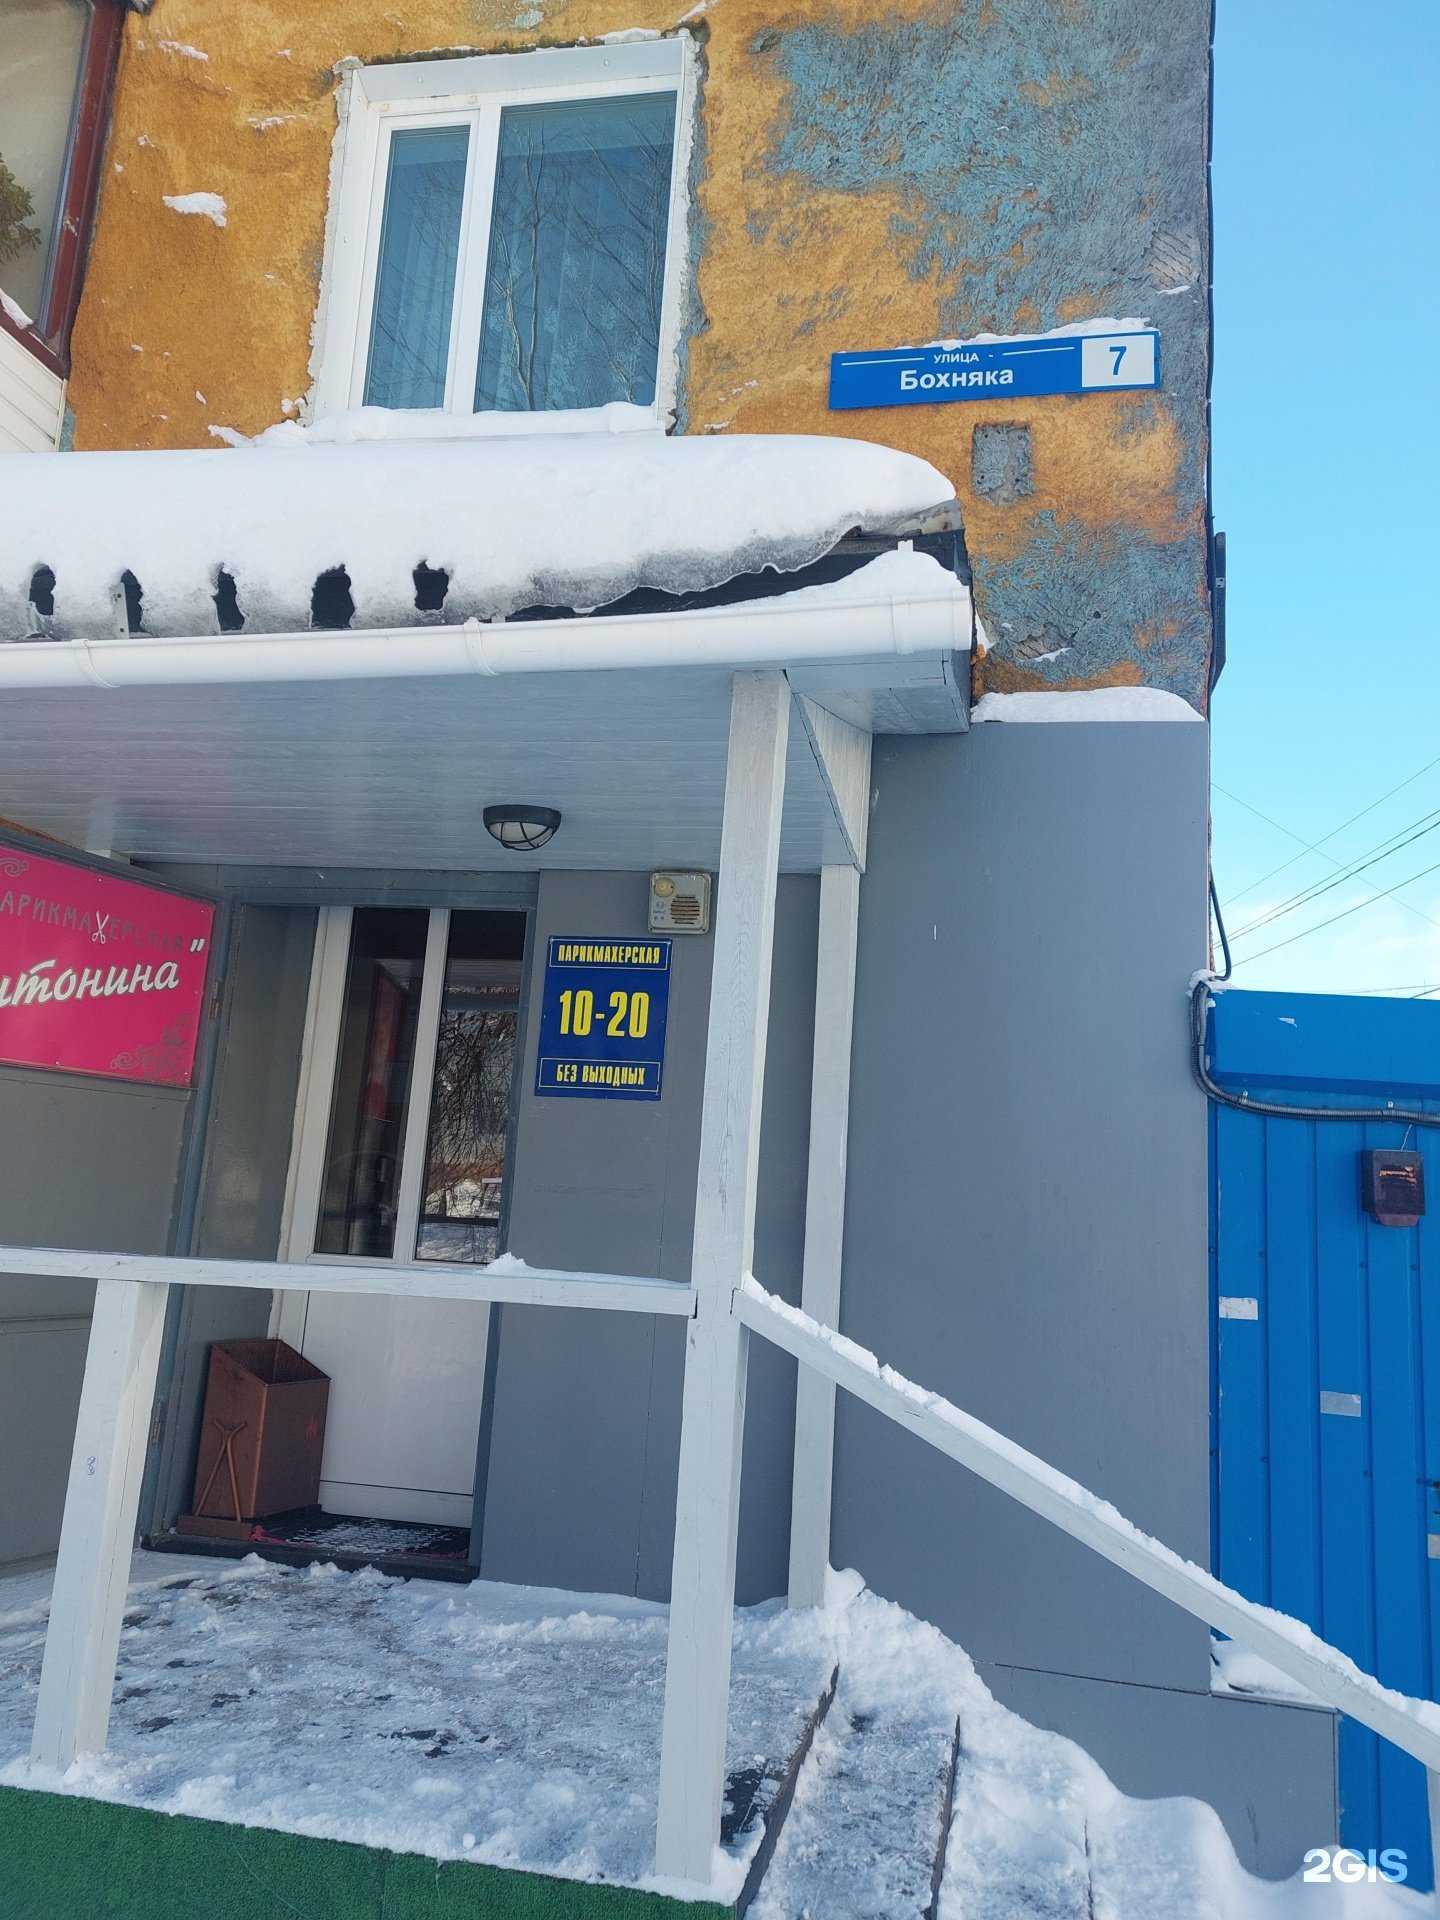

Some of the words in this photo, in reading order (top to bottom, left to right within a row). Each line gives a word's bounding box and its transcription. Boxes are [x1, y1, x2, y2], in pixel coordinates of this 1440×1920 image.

[933, 352, 980, 364] УЛИЦА
[1109, 345, 1127, 376] 7
[900, 368, 1014, 390] Бохняка
[558, 944, 660, 964] ПАРИКМАХЕРСКАЯ
[559, 990, 650, 1038] 10-20
[556, 1064, 577, 1082] БЕЗ
[582, 1065, 645, 1087] ВЫХОДНЫХ
